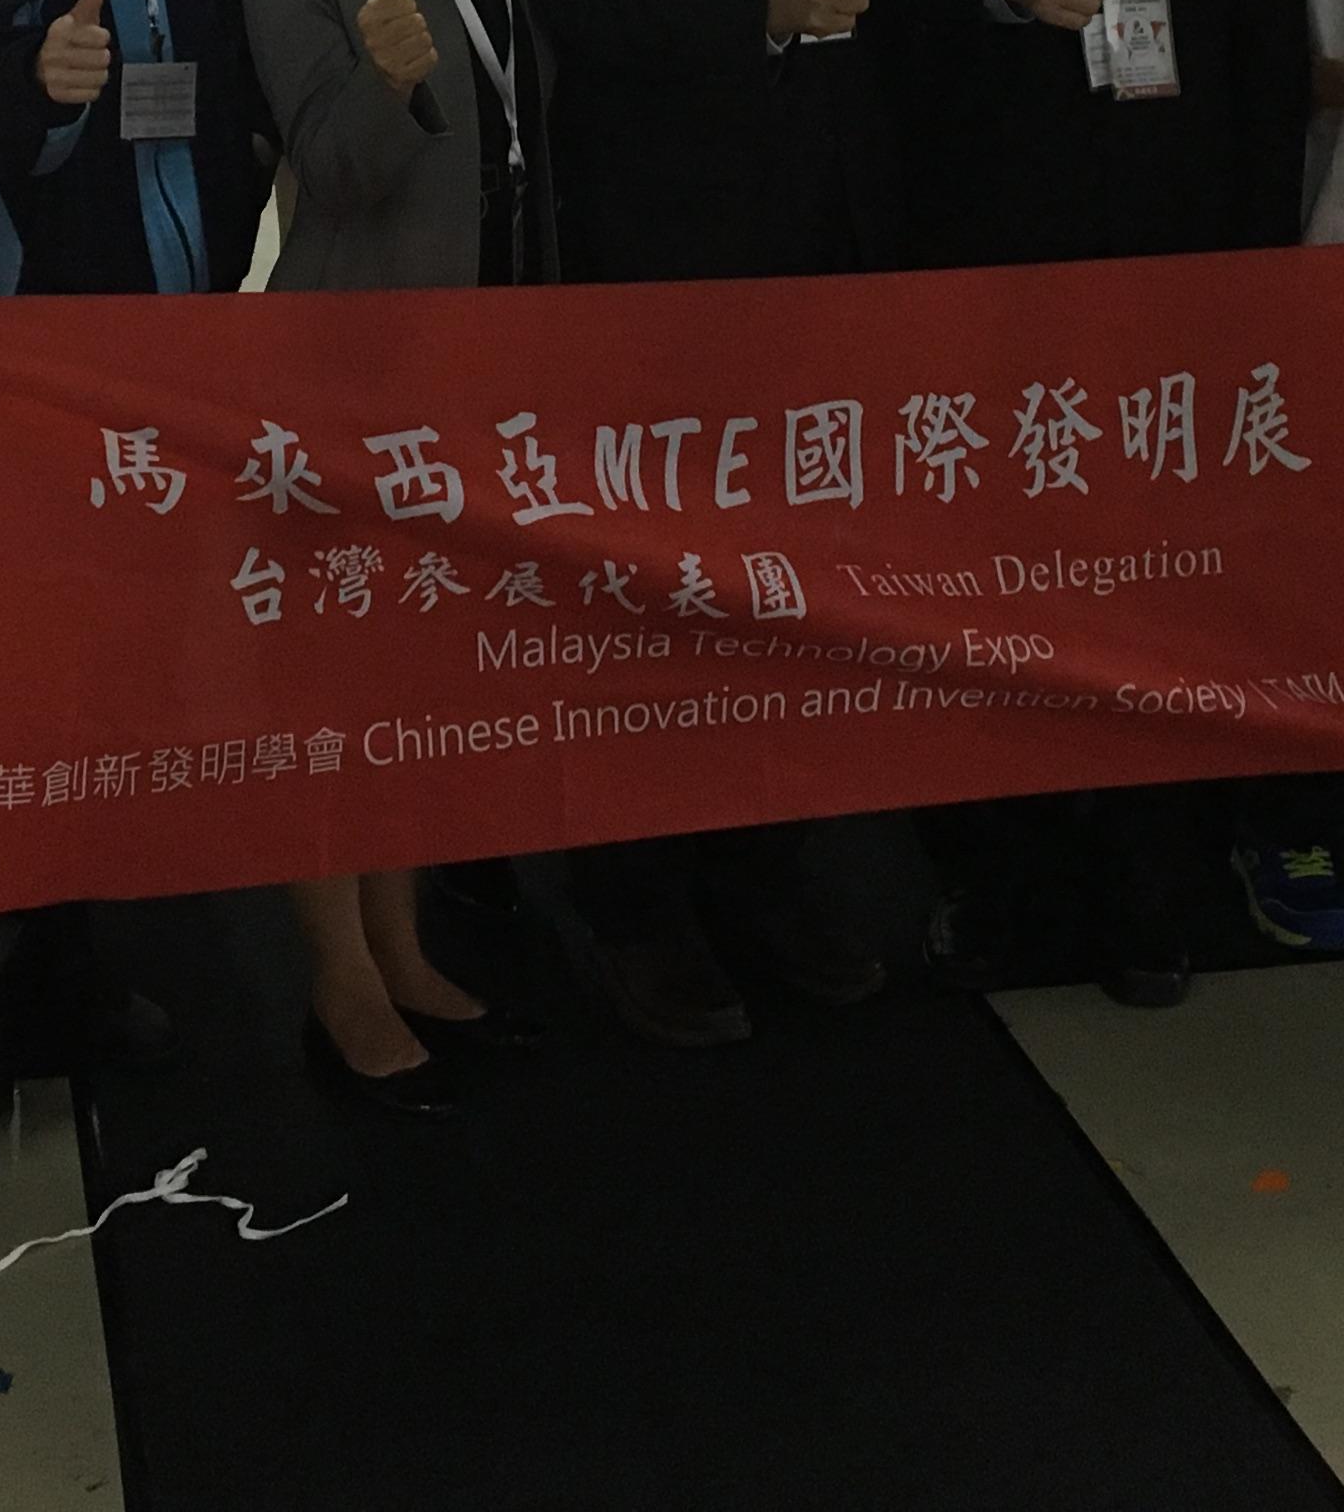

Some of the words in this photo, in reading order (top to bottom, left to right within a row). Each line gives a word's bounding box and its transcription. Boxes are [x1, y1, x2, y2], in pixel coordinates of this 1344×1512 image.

[228, 543, 808, 626] 台灣參展代表團
[835, 562, 984, 600] Taiwan
[991, 540, 1224, 596] Delegation
[476, 624, 671, 675] Malaysia
[690, 630, 950, 673] Technology
[962, 627, 1055, 674] Expo
[362, 711, 540, 766] Chinese
[551, 686, 787, 743] Innovation
[799, 677, 882, 720] and
[892, 678, 1098, 712] Invention
[1113, 677, 1248, 719] Society
